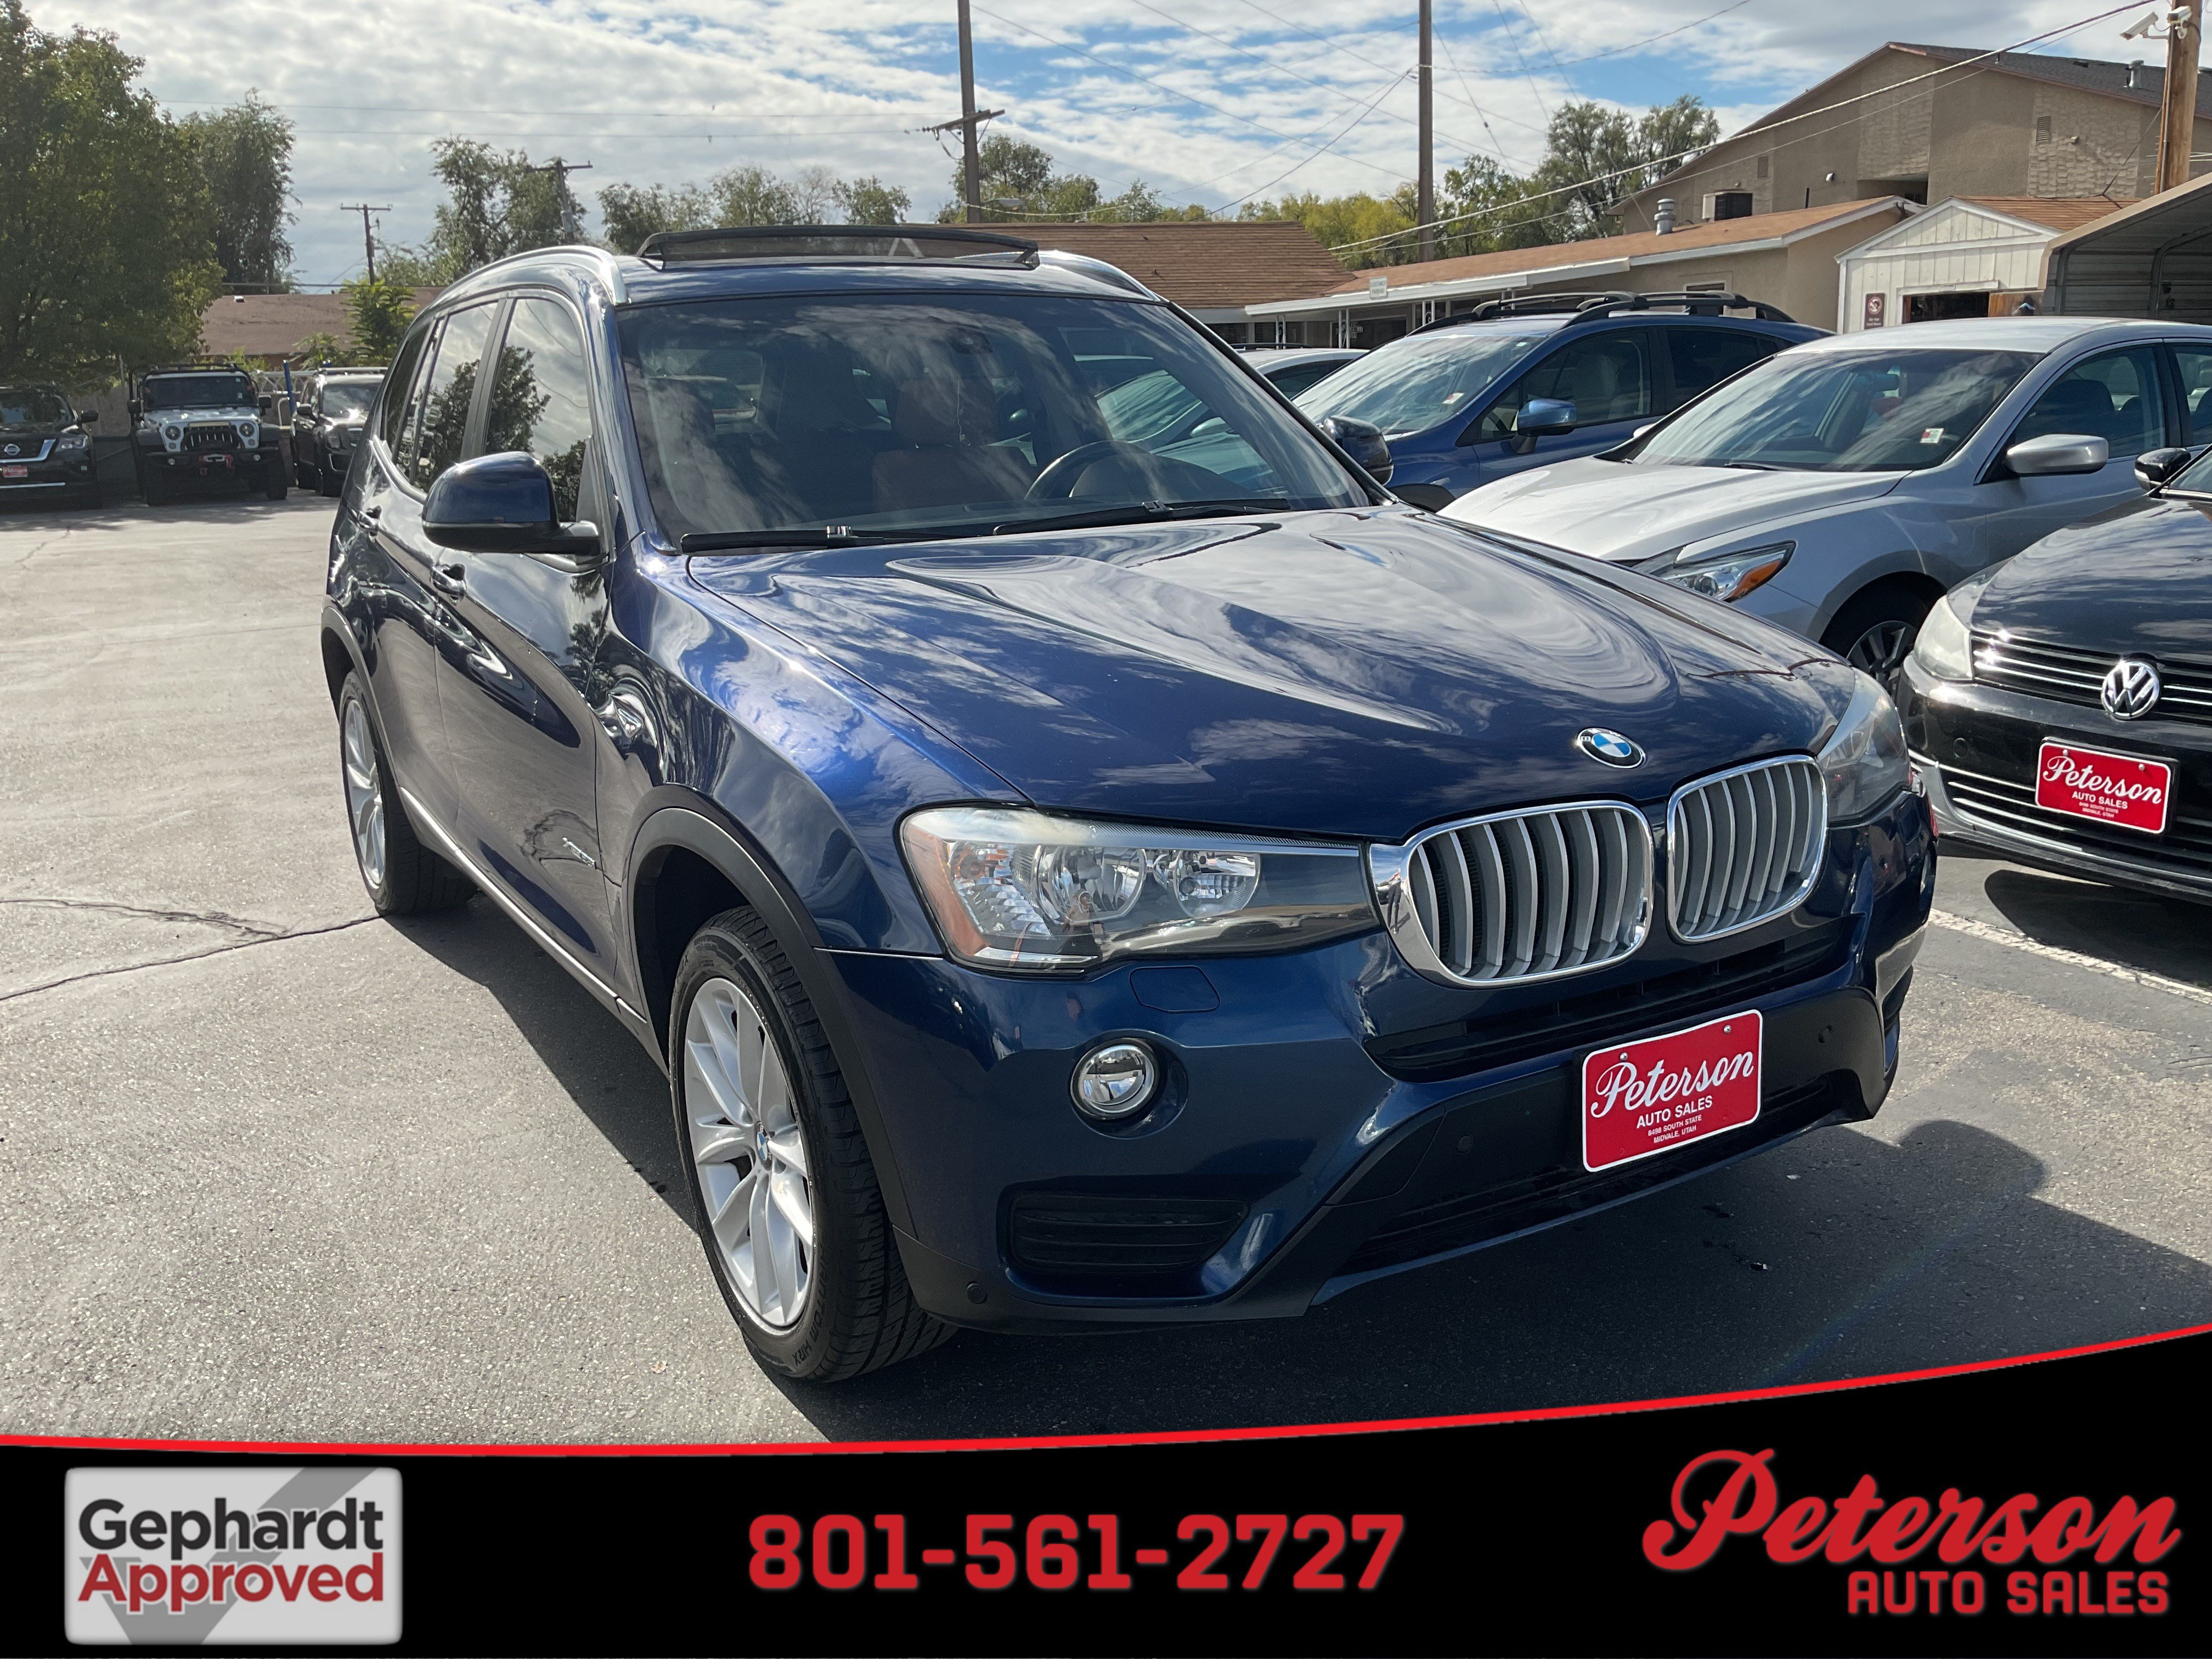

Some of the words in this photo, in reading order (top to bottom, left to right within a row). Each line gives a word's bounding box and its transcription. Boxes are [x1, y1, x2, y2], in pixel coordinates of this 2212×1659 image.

[2042, 755, 2162, 804] Peterson
[2072, 791, 2096, 803] AUTO
[2098, 796, 2128, 809] SALES
[1590, 1051, 1754, 1118] Peterson
[1637, 1108, 1671, 1128] AUTO
[1675, 1095, 1712, 1118] SALES
[1663, 1120, 1684, 1132] SOUTH
[1685, 1114, 1702, 1125] STATE
[1681, 1125, 1697, 1135] UTAH
